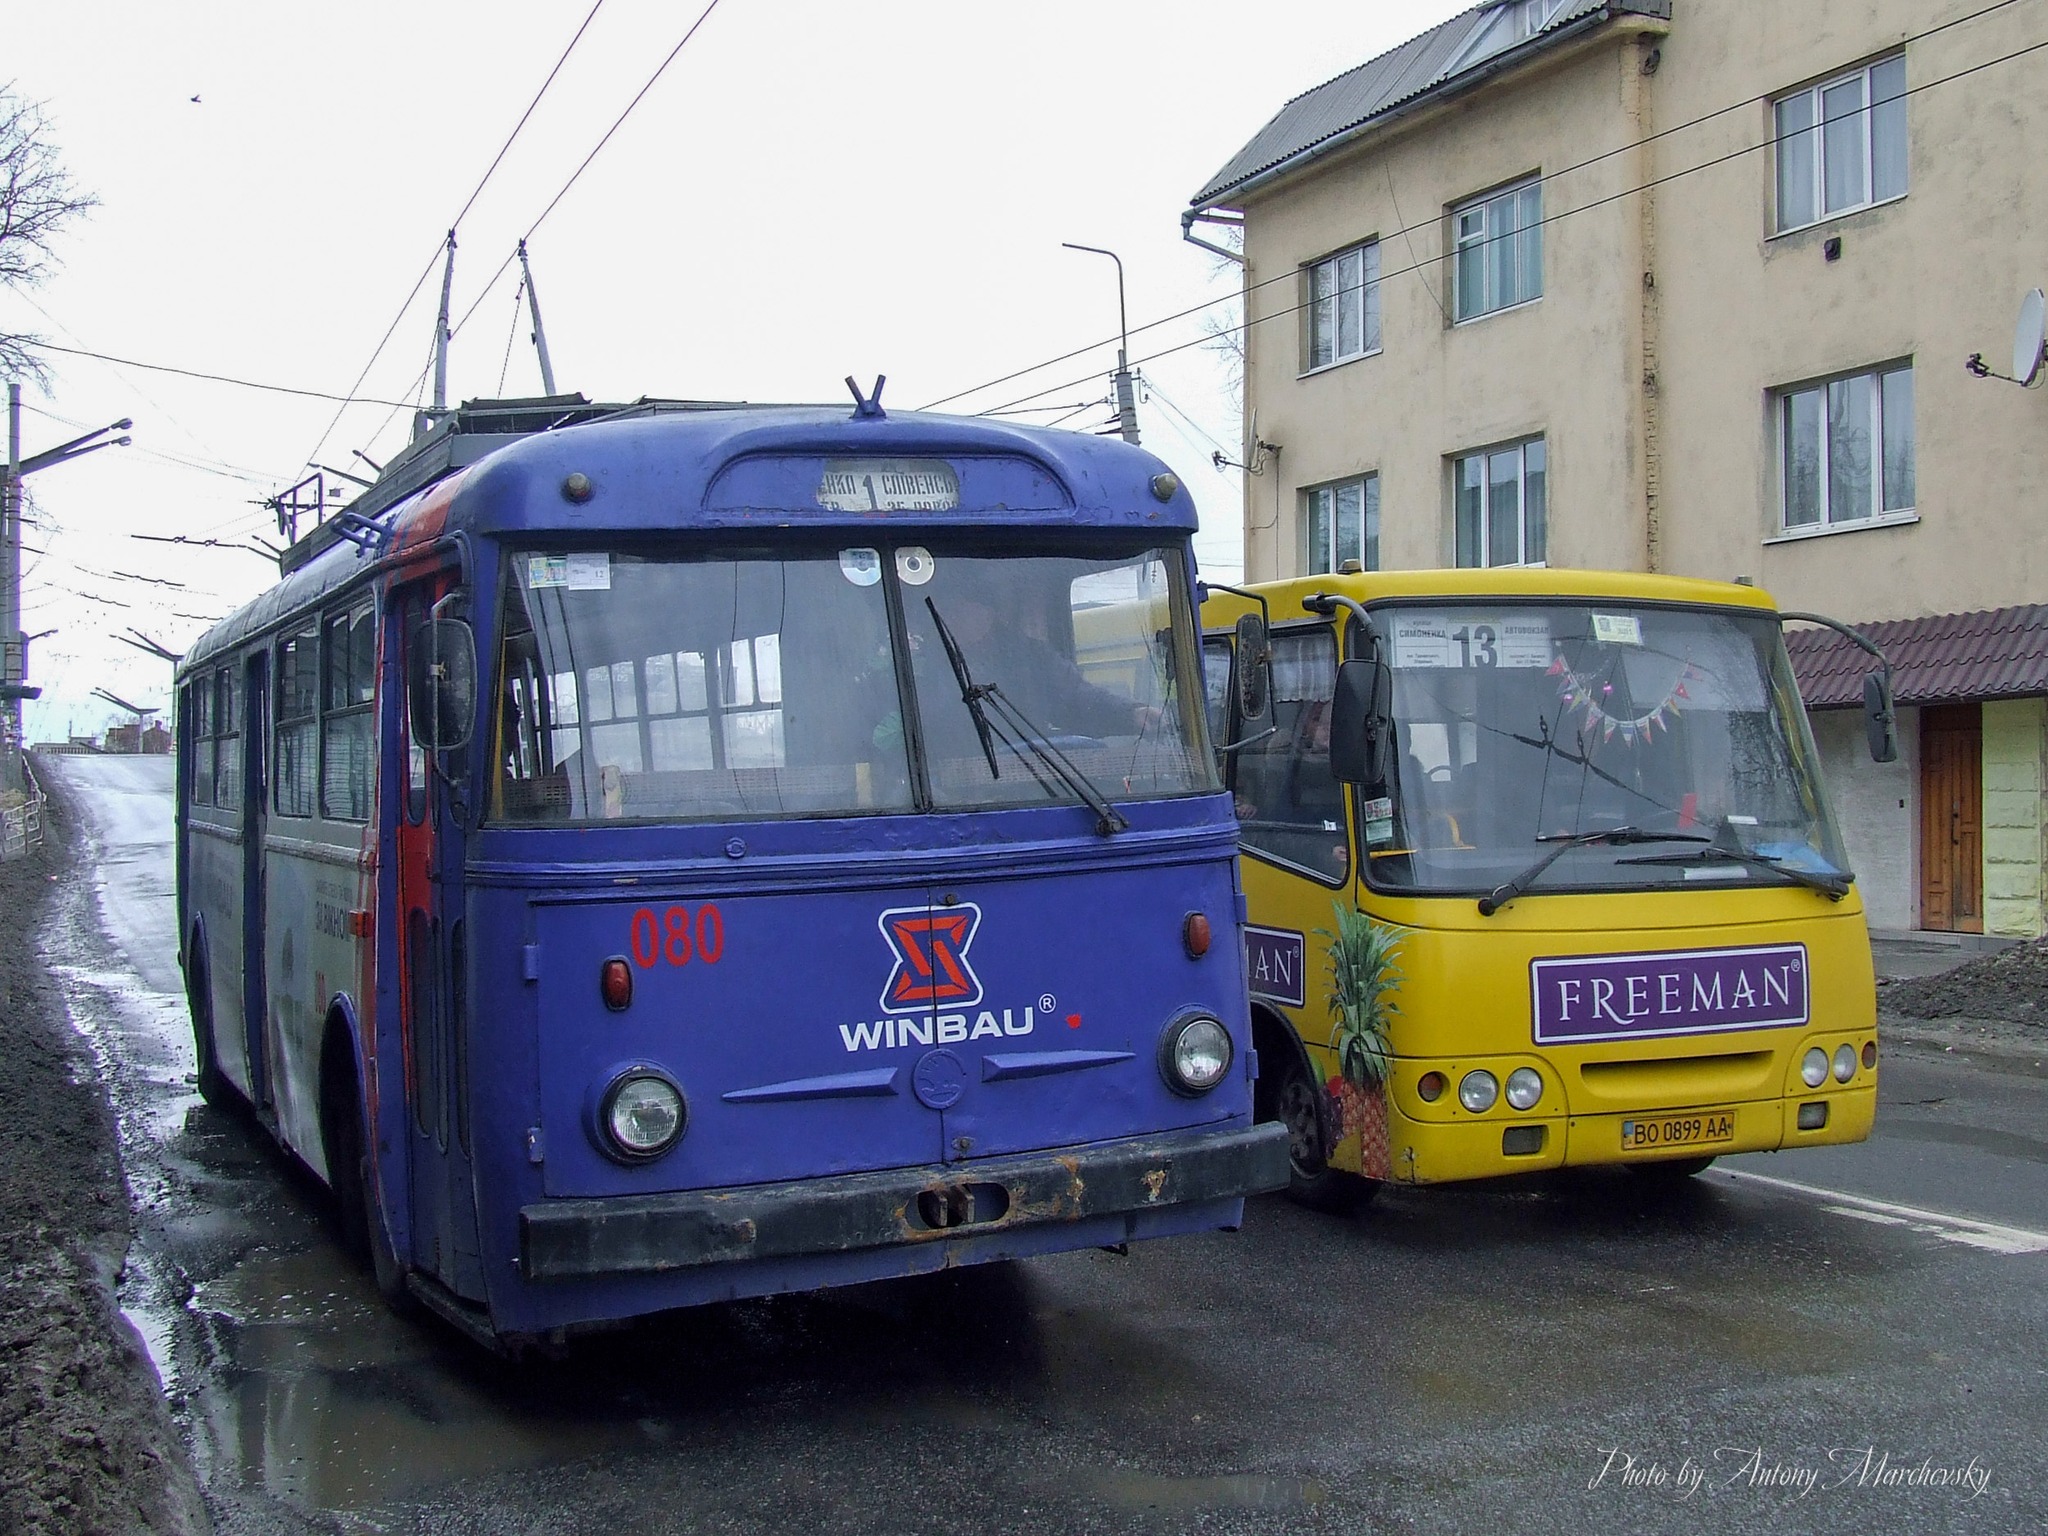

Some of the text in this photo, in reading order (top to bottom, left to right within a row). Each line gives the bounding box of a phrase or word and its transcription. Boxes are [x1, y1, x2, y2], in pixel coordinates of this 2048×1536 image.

[862, 474, 878, 510] 1
[1452, 625, 1498, 668] 13
[630, 903, 724, 969] 080
[1557, 965, 1790, 1026] FREEMAN
[838, 1006, 1034, 1053] WINBAU
[1634, 1117, 1729, 1144] BO 0899 AA
